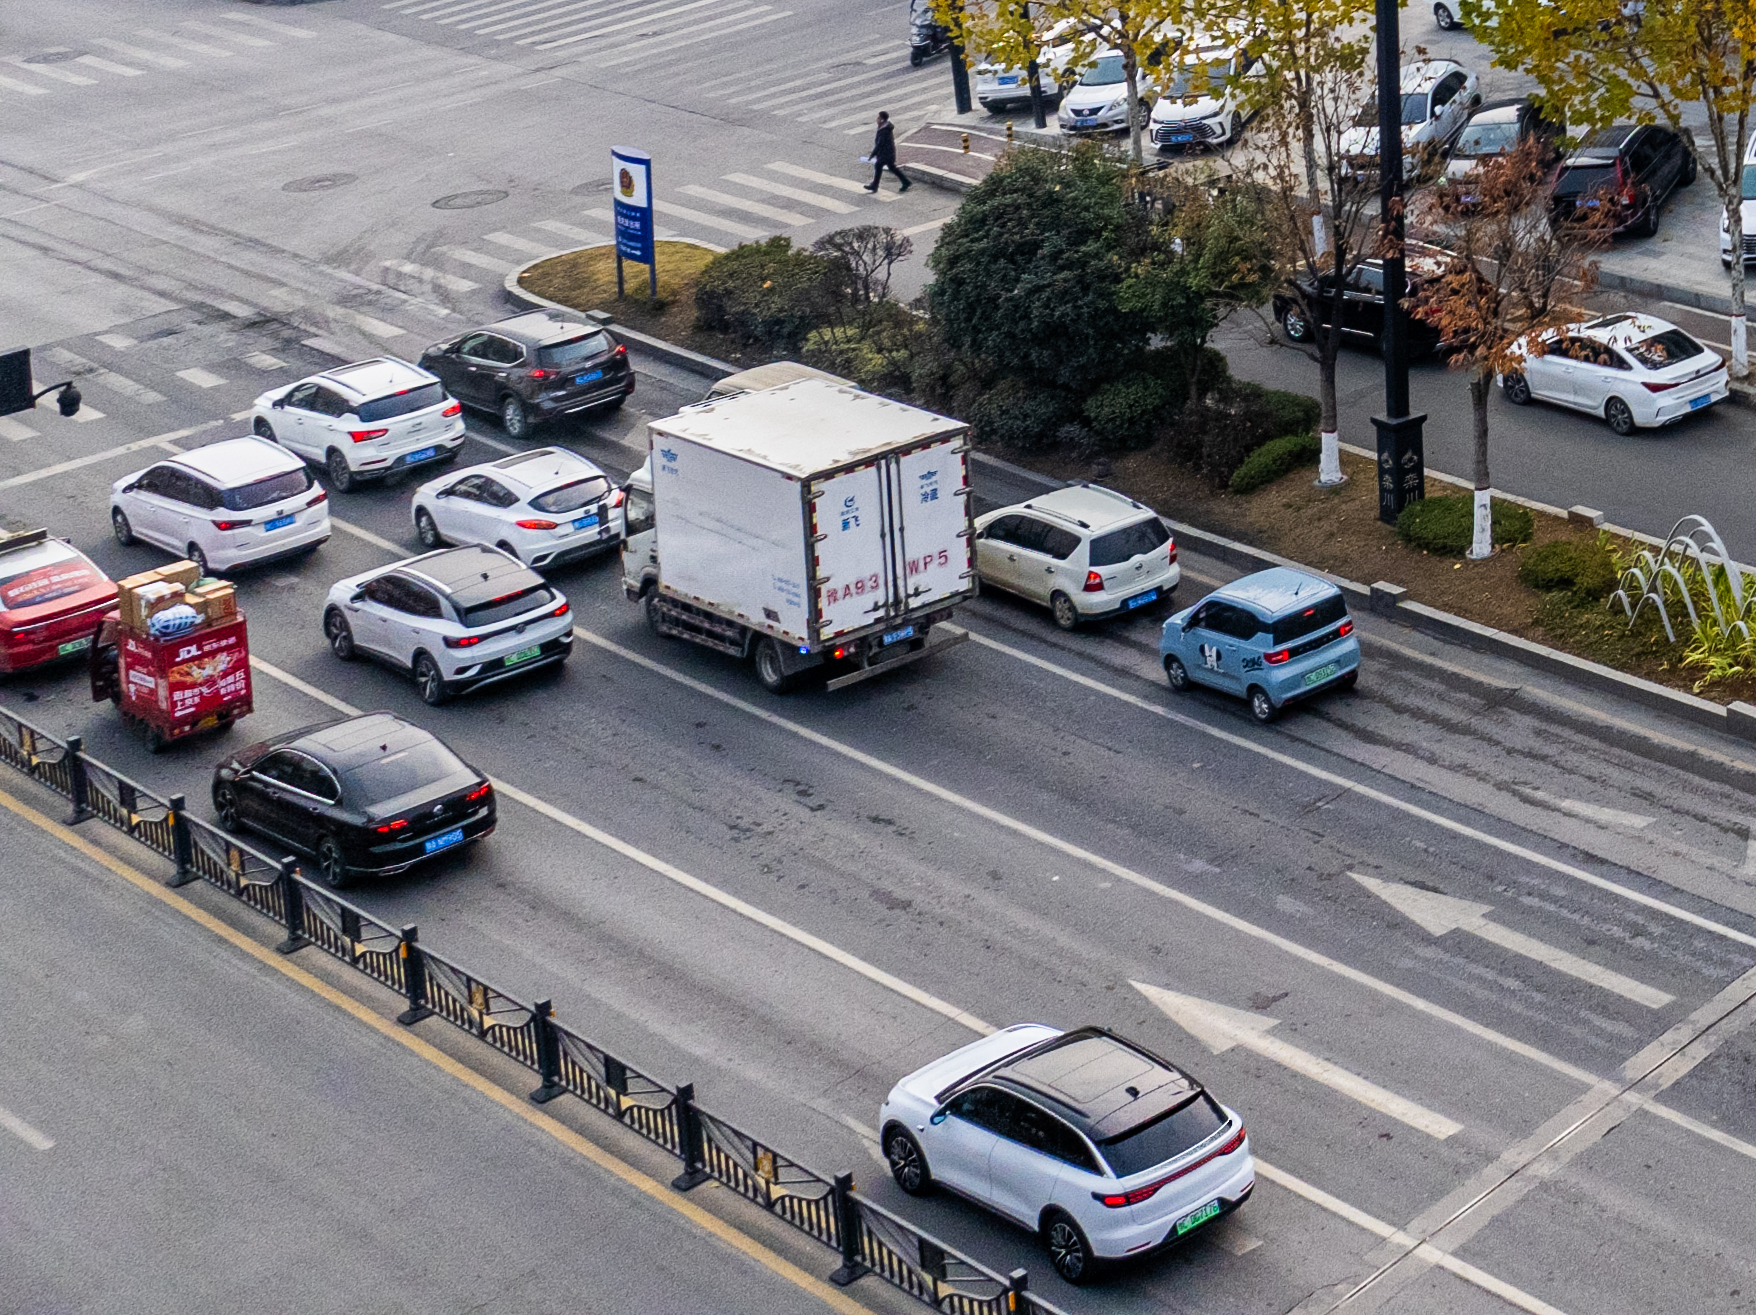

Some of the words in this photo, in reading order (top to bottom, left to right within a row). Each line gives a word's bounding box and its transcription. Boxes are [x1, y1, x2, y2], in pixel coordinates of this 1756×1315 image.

[826, 573, 880, 606] 豫A93
[907, 548, 949, 577] WP5
[174, 644, 202, 662] JDL
